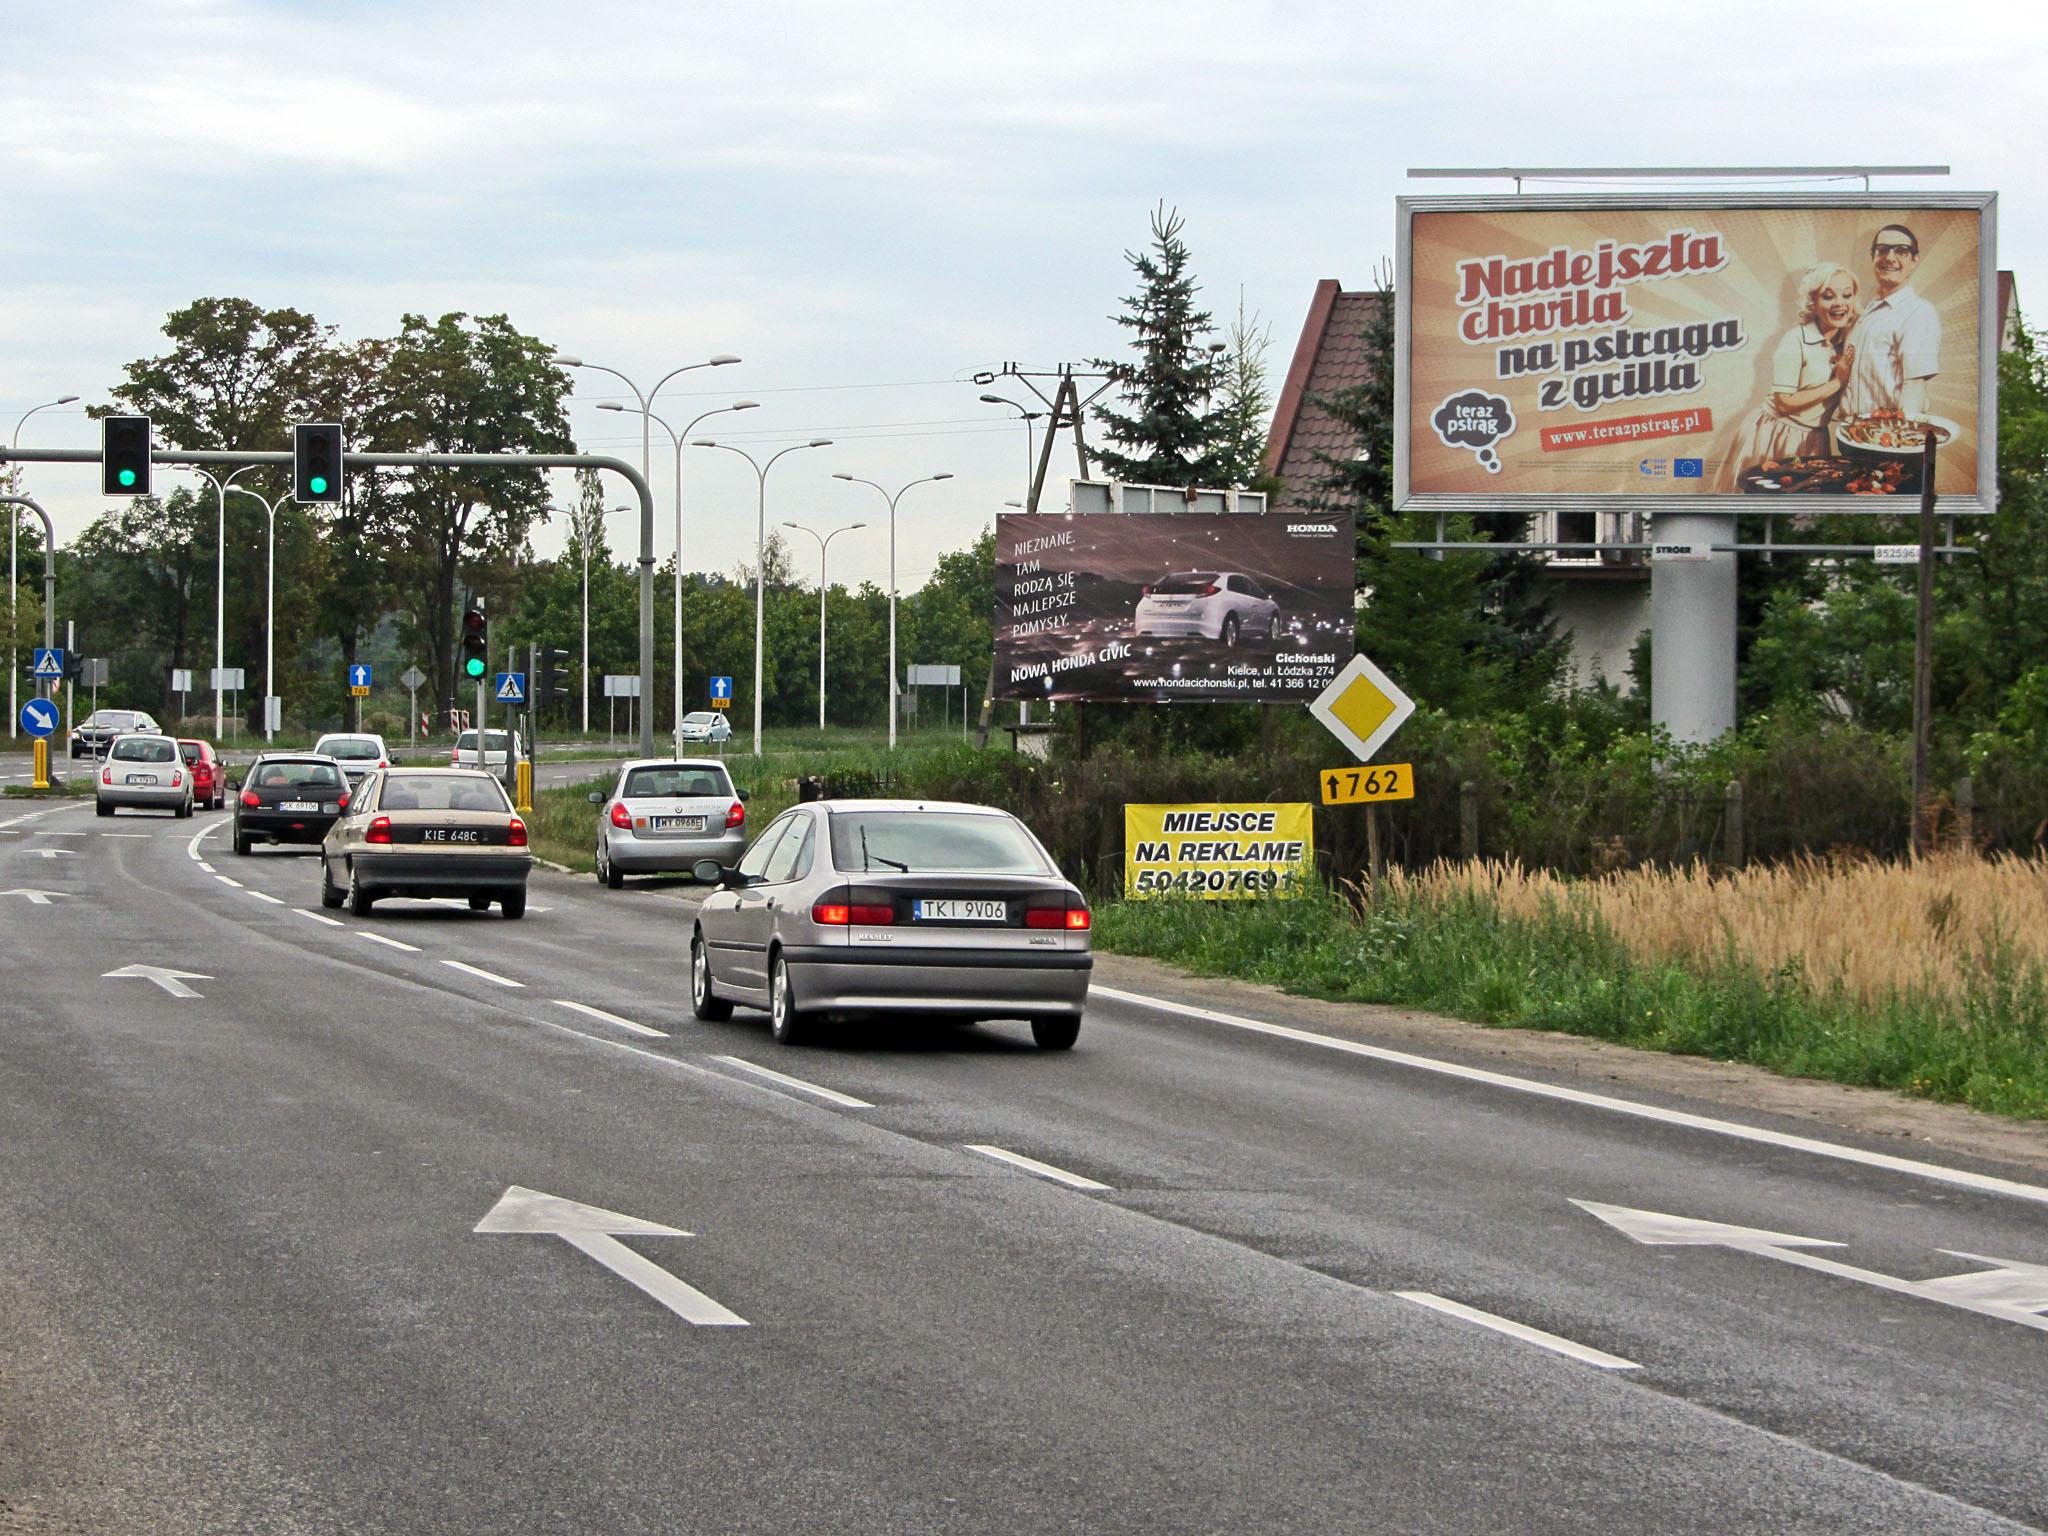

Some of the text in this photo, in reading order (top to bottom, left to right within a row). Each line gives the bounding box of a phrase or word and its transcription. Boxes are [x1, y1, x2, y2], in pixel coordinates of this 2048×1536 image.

[1460, 233, 1724, 301] Nadejszła
[1463, 290, 1627, 340] chwila
[1499, 343, 1557, 375] na
[1541, 381, 1563, 407] z
[1456, 404, 1493, 418] teraz
[1447, 417, 1498, 435] pstrąg
[1550, 411, 1699, 444] www.terazpstrag.pl
[1287, 524, 1338, 532] HONDA
[1014, 531, 1076, 557] NIEZNANE.
[1016, 559, 1040, 576] TAM
[1014, 571, 1075, 597] RODZĄ SIĘ
[1013, 591, 1076, 617] NAJLEPSZE
[1012, 613, 1070, 637] POMYSŁY.
[1011, 643, 1132, 682] NOWA HONDA CIVIC
[1275, 652, 1335, 663] Cichoński
[1228, 665, 1334, 677] Kielce, ul. Łódzka 274
[353, 687, 368, 695] 762
[1252, 678, 1267, 688] tel.
[1270, 679, 1282, 688] 41
[1285, 679, 1304, 688] 366
[1308, 679, 1319, 688] 12
[1321, 679, 1332, 688] 0
[1346, 770, 1398, 796] 762
[662, 818, 673, 827] WY
[1163, 812, 1275, 832] MIEJSCE
[424, 830, 478, 842] KIE 648C
[1135, 841, 1303, 862] NA REKLAME
[924, 901, 1003, 918] TKI 9V06
